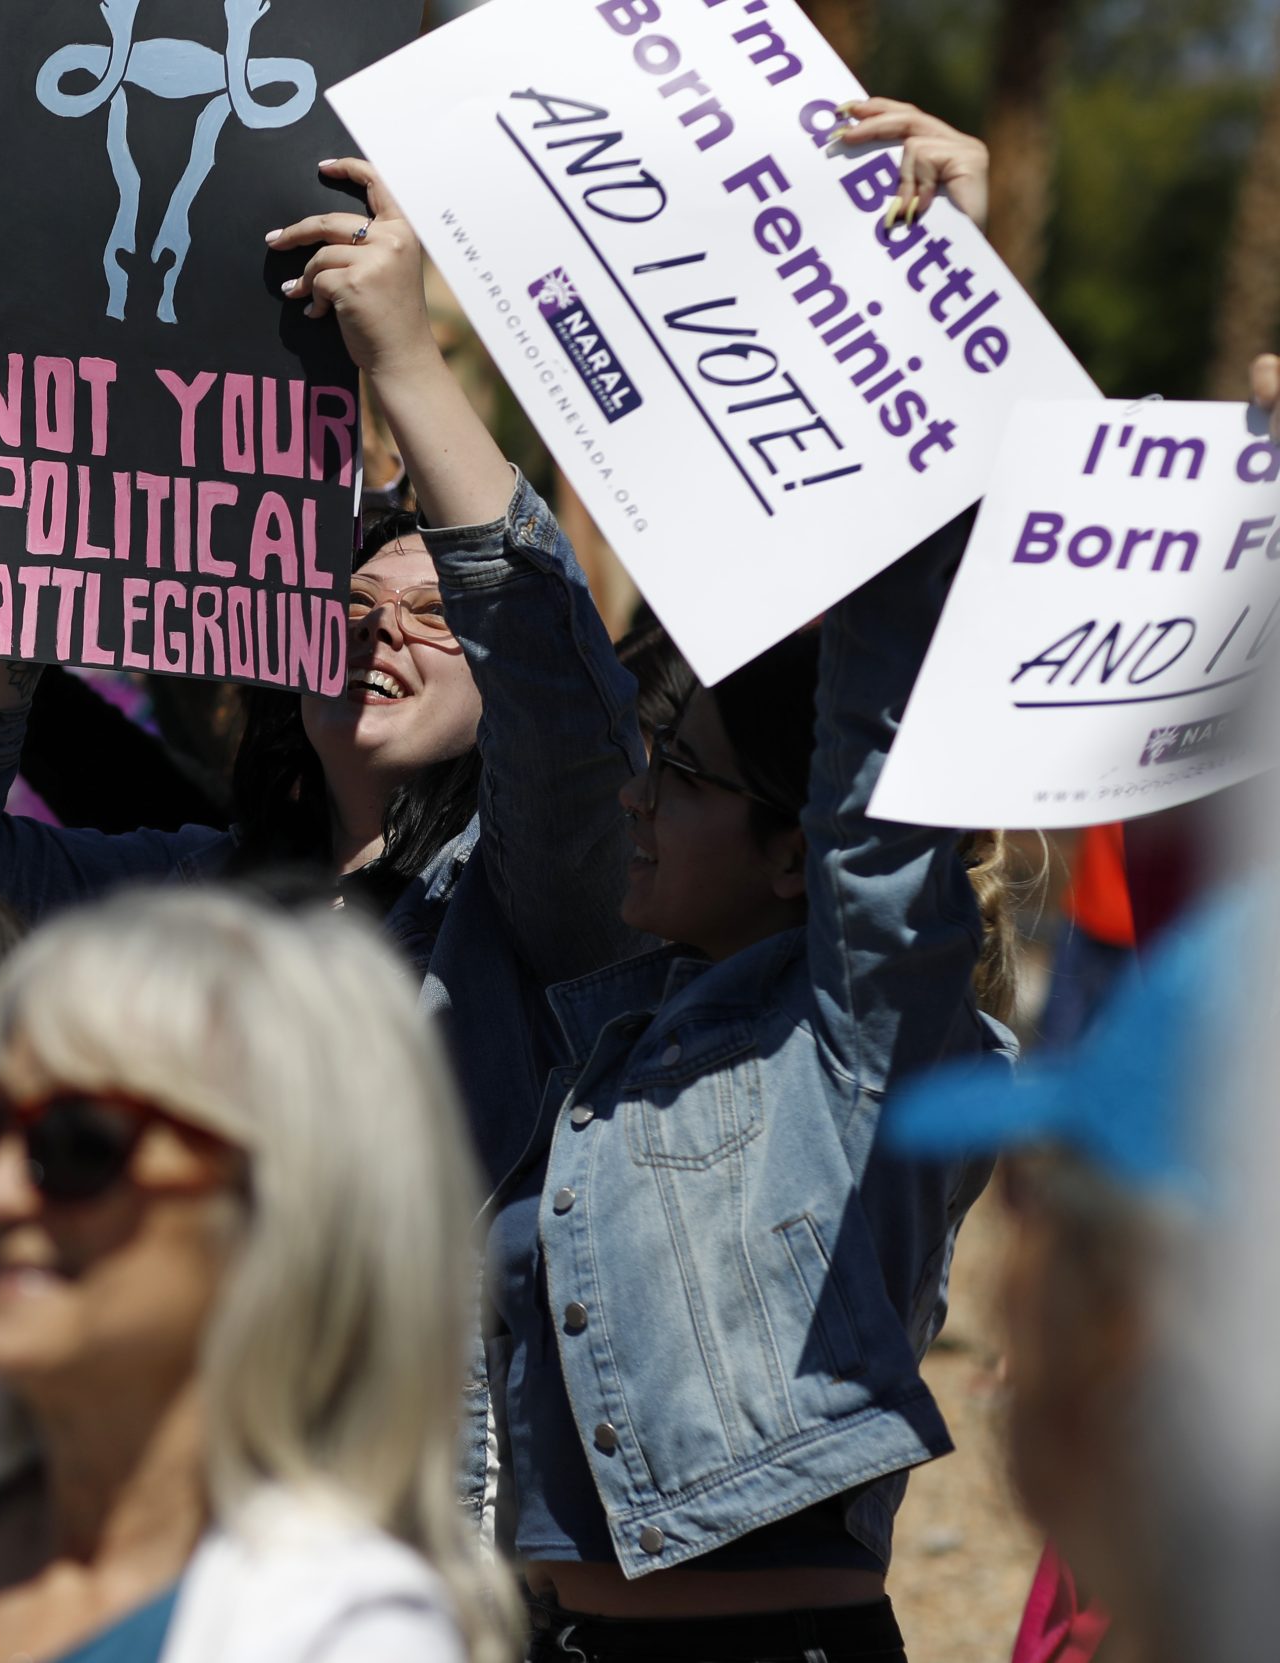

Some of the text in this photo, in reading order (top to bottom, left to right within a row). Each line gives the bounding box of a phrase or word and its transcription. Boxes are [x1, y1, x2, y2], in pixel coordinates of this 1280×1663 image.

[596, 0, 958, 473] Born Feminist
[702, 0, 1010, 373] 'm a Battle
[510, 87, 862, 491] AND I VOTE!
[441, 208, 648, 534] WWW.PROCHOICENEVADA.ORG
[563, 310, 631, 409] NARAL
[155, 369, 356, 487] YOUR
[1082, 424, 1206, 480] I'm
[1012, 511, 1200, 572] Born
[1010, 616, 1197, 685] AND
